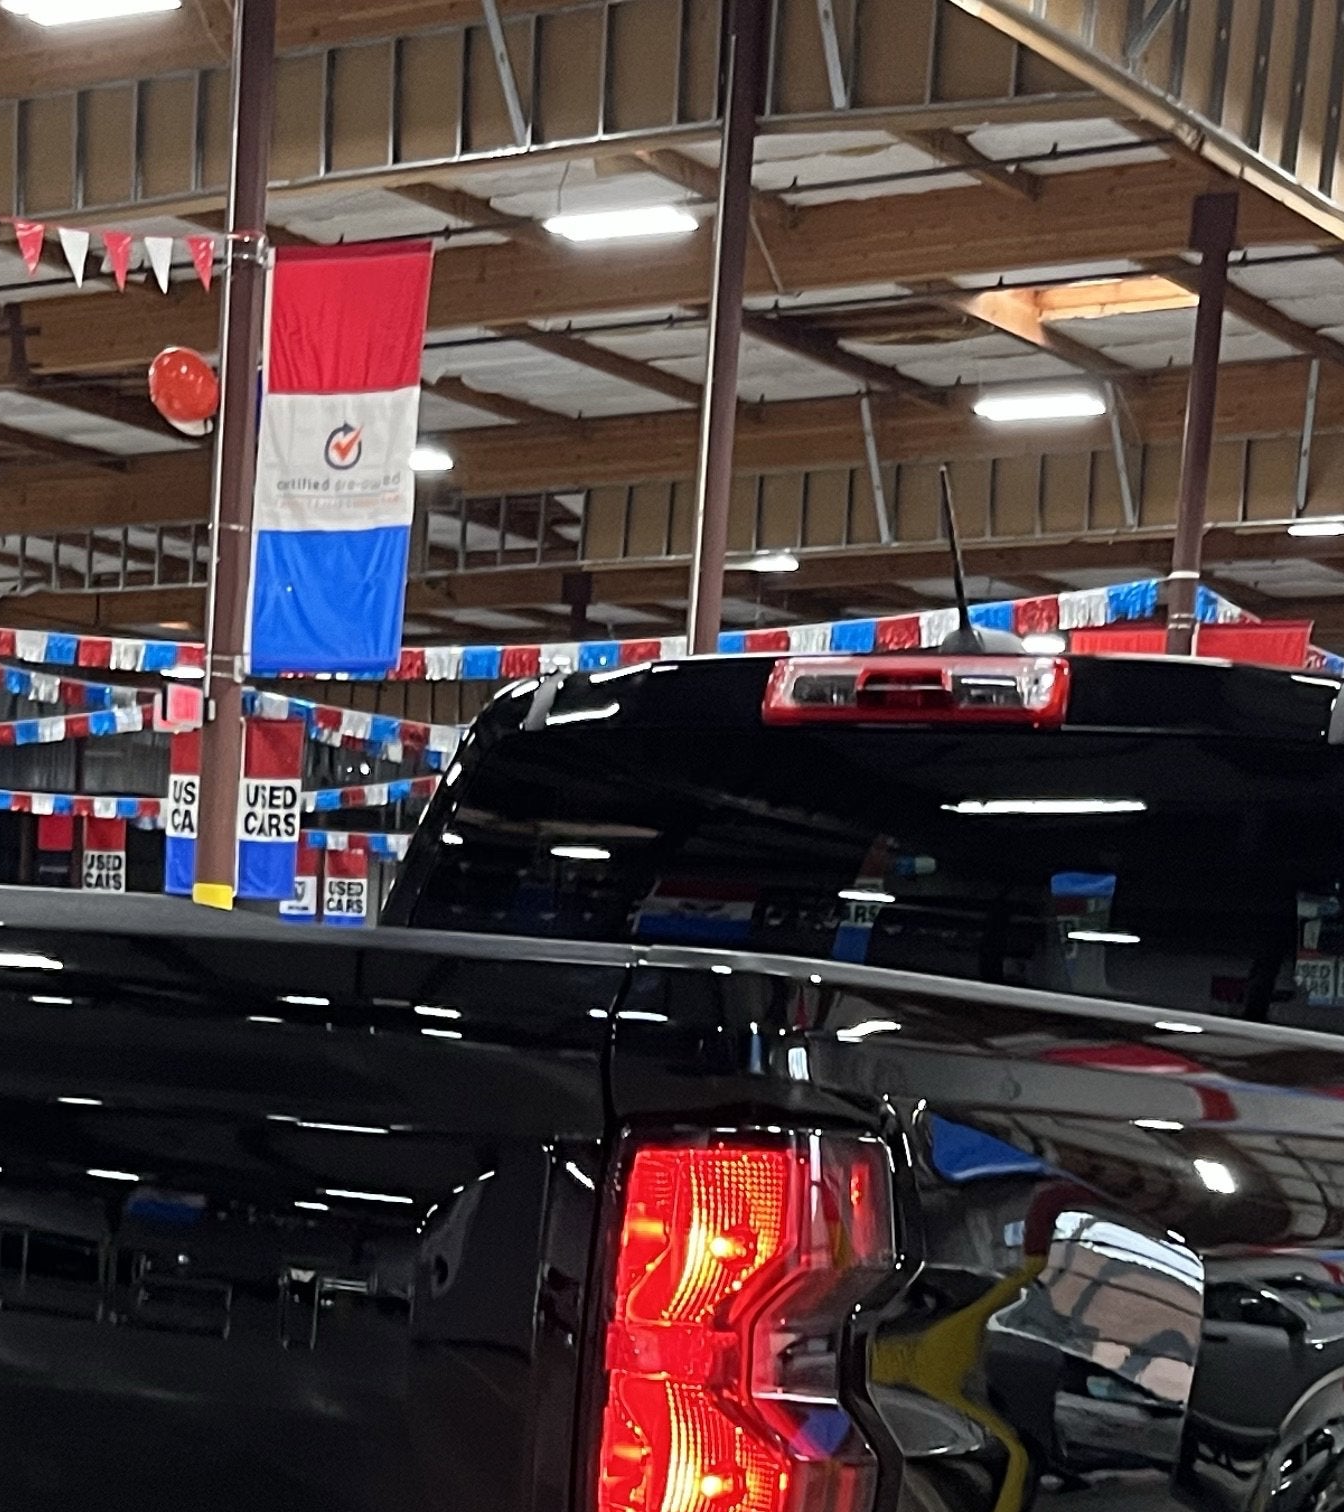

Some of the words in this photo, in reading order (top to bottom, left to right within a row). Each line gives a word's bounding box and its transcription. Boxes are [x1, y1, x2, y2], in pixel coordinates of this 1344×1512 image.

[173, 780, 196, 805] US
[246, 784, 298, 810] USED
[171, 808, 194, 833] CA
[244, 811, 296, 837] CARS
[85, 854, 122, 871] USED
[328, 881, 364, 897] USED
[326, 897, 364, 914] CARS
